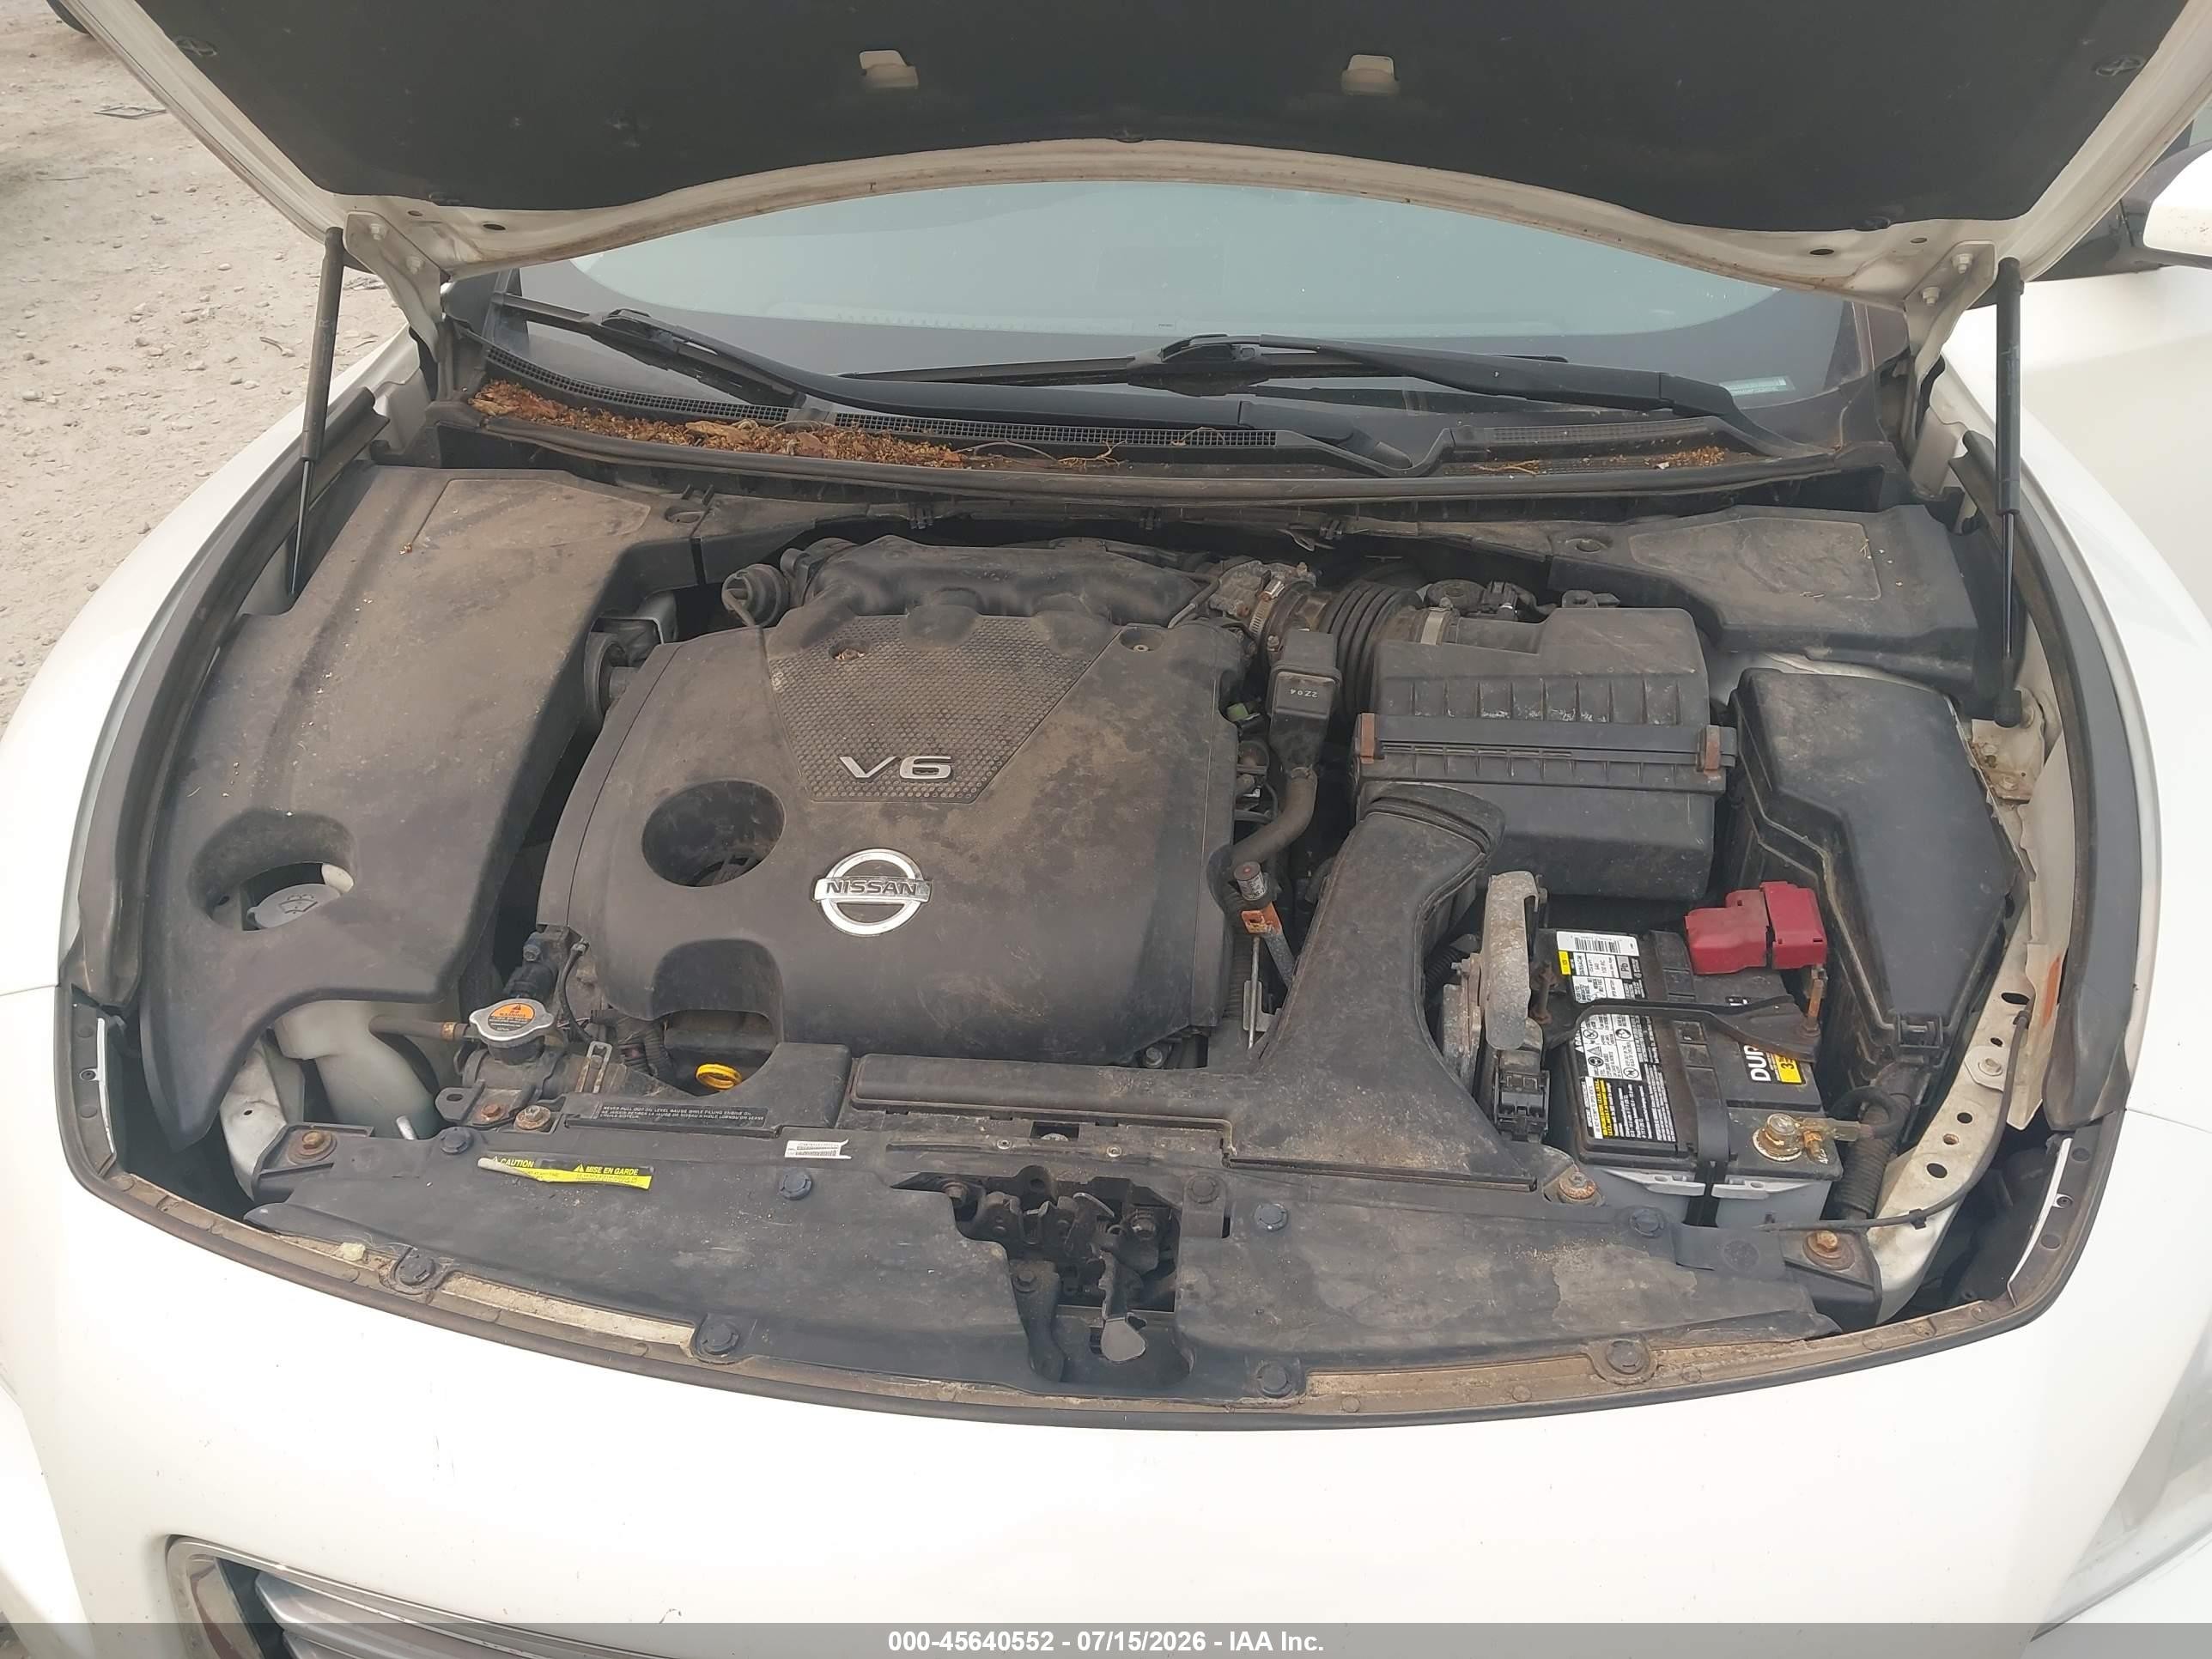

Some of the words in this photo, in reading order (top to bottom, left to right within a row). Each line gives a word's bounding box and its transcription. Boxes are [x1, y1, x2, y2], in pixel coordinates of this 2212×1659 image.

[839, 756, 954, 780] V6
[826, 878, 918, 896] NISSAN
[499, 1158, 535, 1168] CAUTION
[585, 1165, 605, 1174] MISE
